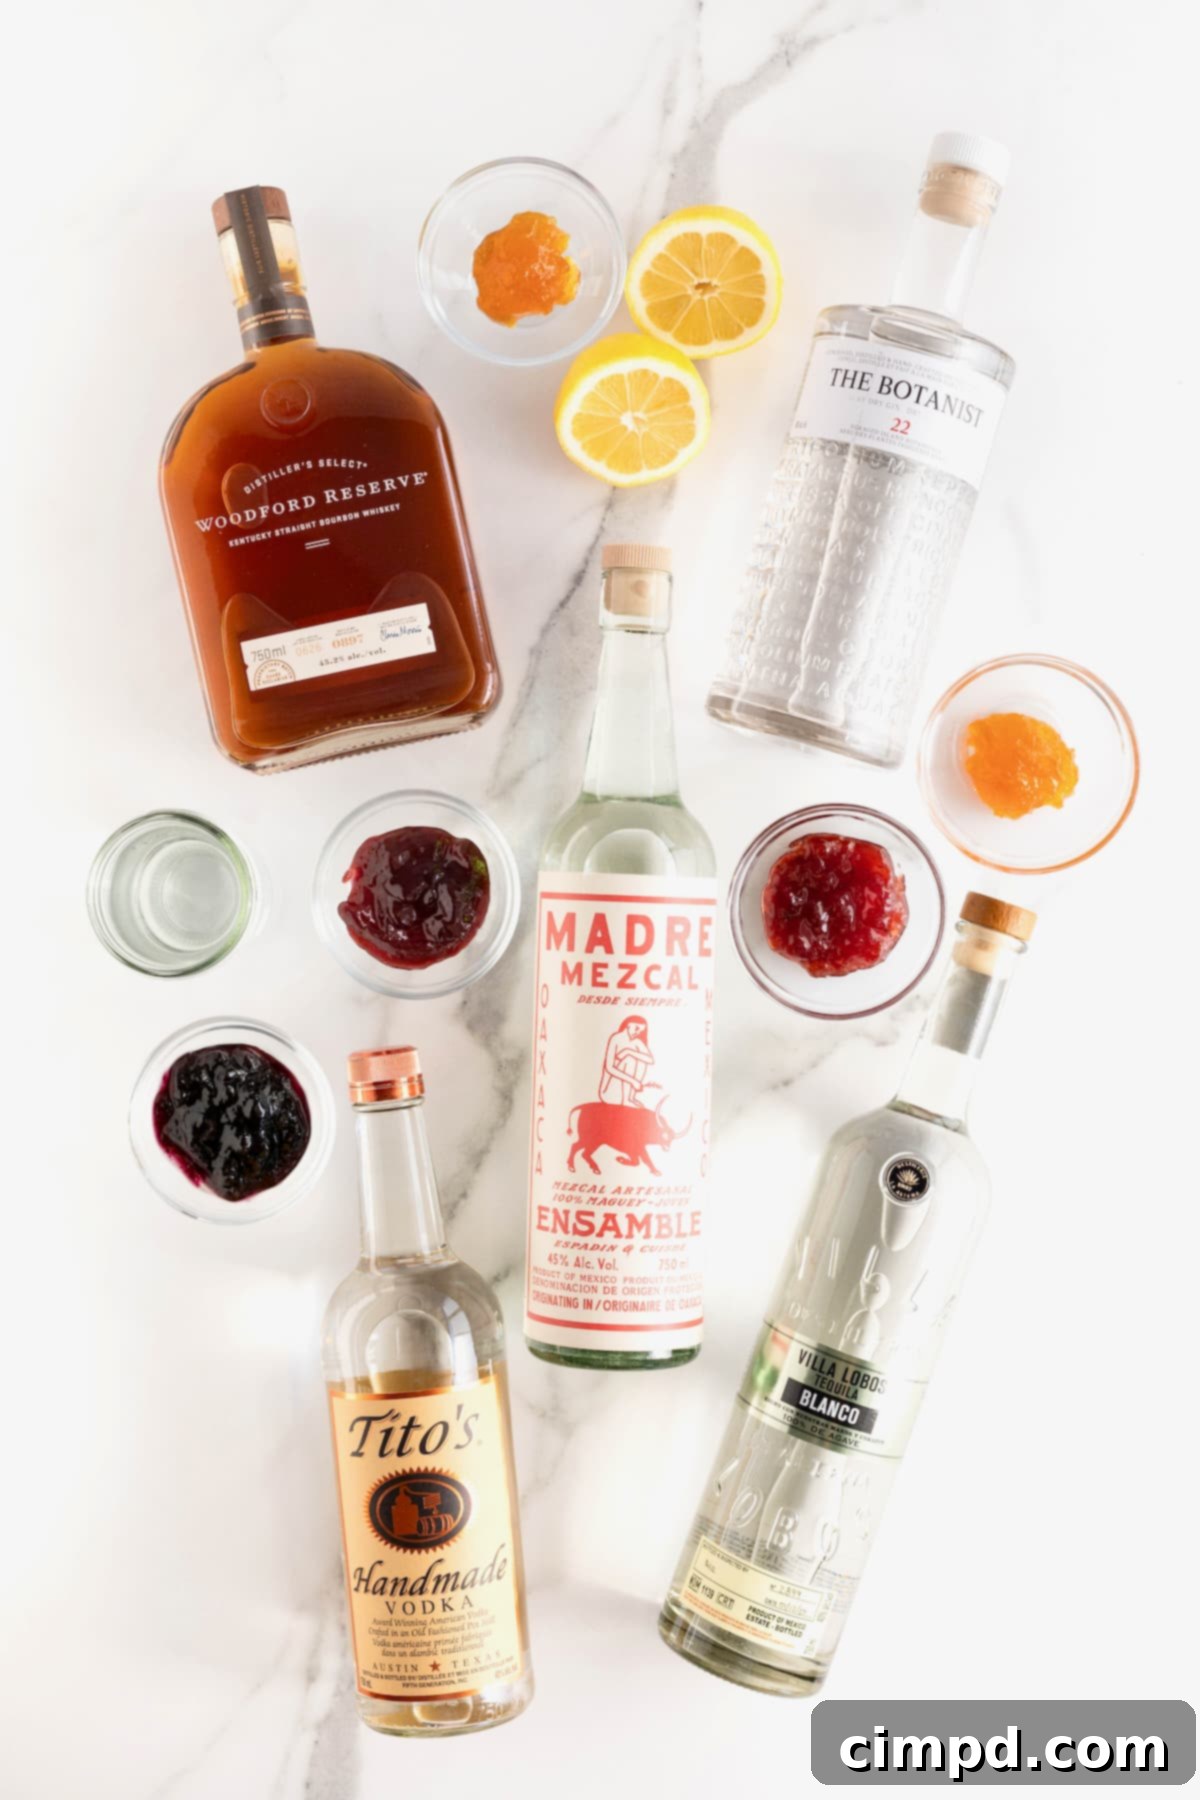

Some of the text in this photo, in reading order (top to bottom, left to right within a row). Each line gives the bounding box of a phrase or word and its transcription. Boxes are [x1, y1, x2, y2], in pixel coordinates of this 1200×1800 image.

[830, 368, 874, 391] THE
[877, 375, 984, 428] BOTANIST
[890, 417, 911, 435] 22
[243, 459, 313, 495] DISTILLER'S
[195, 472, 425, 533] WOODFORD RESERVE
[228, 503, 401, 548] KENTUCKY STRAIGHT BOURBON WHISKEY
[250, 645, 287, 662] 750ml
[546, 911, 712, 957] MADRE
[561, 961, 698, 990] MEZCAL
[577, 995, 620, 1005] DESDE
[536, 983, 549, 1175] OAXACA
[552, 1181, 606, 1194] MEZCAL
[553, 1194, 583, 1204] 100%
[536, 1205, 702, 1239] ENSAMBLE
[554, 1240, 618, 1252] ESPADIN
[547, 1253, 619, 1271] 45% Alc. Vol.
[659, 1258, 676, 1270] 750
[564, 1272, 575, 1280] OF
[579, 1274, 617, 1284] MEXICO
[602, 1286, 618, 1295] DE
[622, 1286, 660, 1296] ORIGEN
[798, 1349, 887, 1395] VILLA LOBOS
[814, 1374, 859, 1401] TEQUILA
[799, 1389, 860, 1424] BLANCO
[349, 1404, 479, 1458] Tito's
[810, 1425, 825, 1436] DE
[828, 1432, 860, 1447] AGAVE
[353, 1543, 507, 1597] Handmade
[385, 1595, 474, 1615] VODKA
[429, 1614, 466, 1625] American
[746, 1613, 770, 1628] ESTATE
[372, 1662, 418, 1672] AUSTIN
